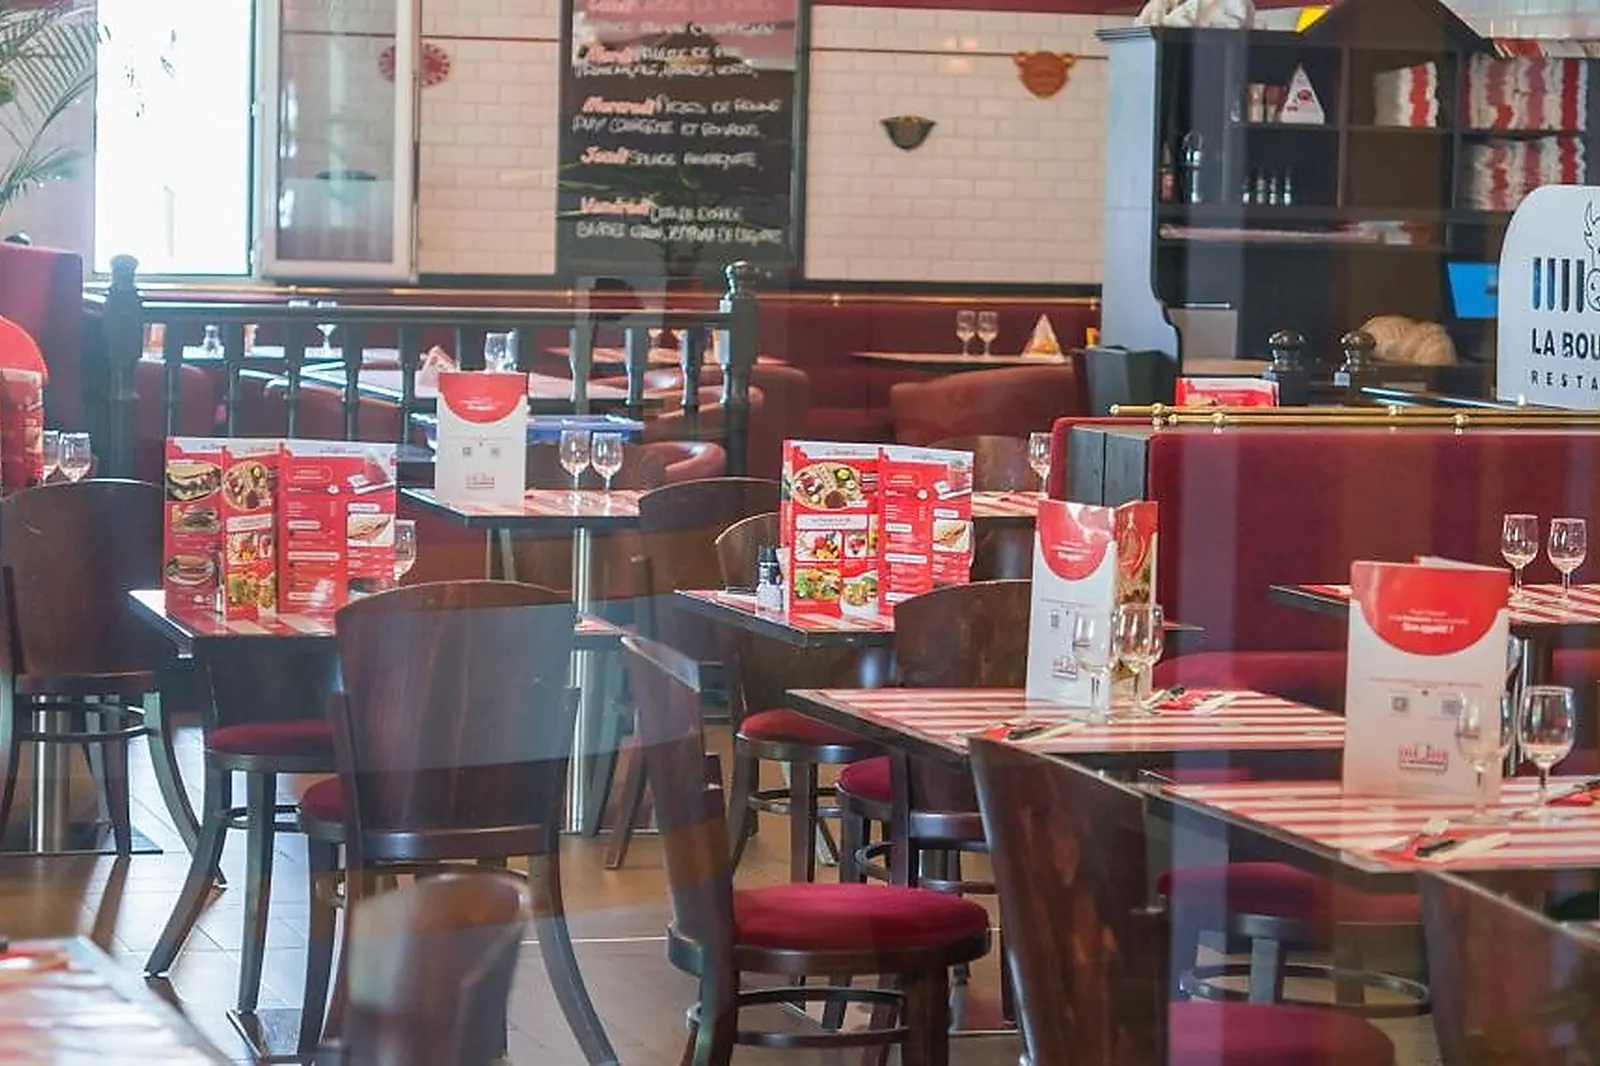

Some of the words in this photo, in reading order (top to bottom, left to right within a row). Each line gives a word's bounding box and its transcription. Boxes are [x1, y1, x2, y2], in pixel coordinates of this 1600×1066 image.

[1532, 327, 1555, 356] LA
[1562, 332, 1600, 360] BOU
[1531, 370, 1599, 390] RESTA
